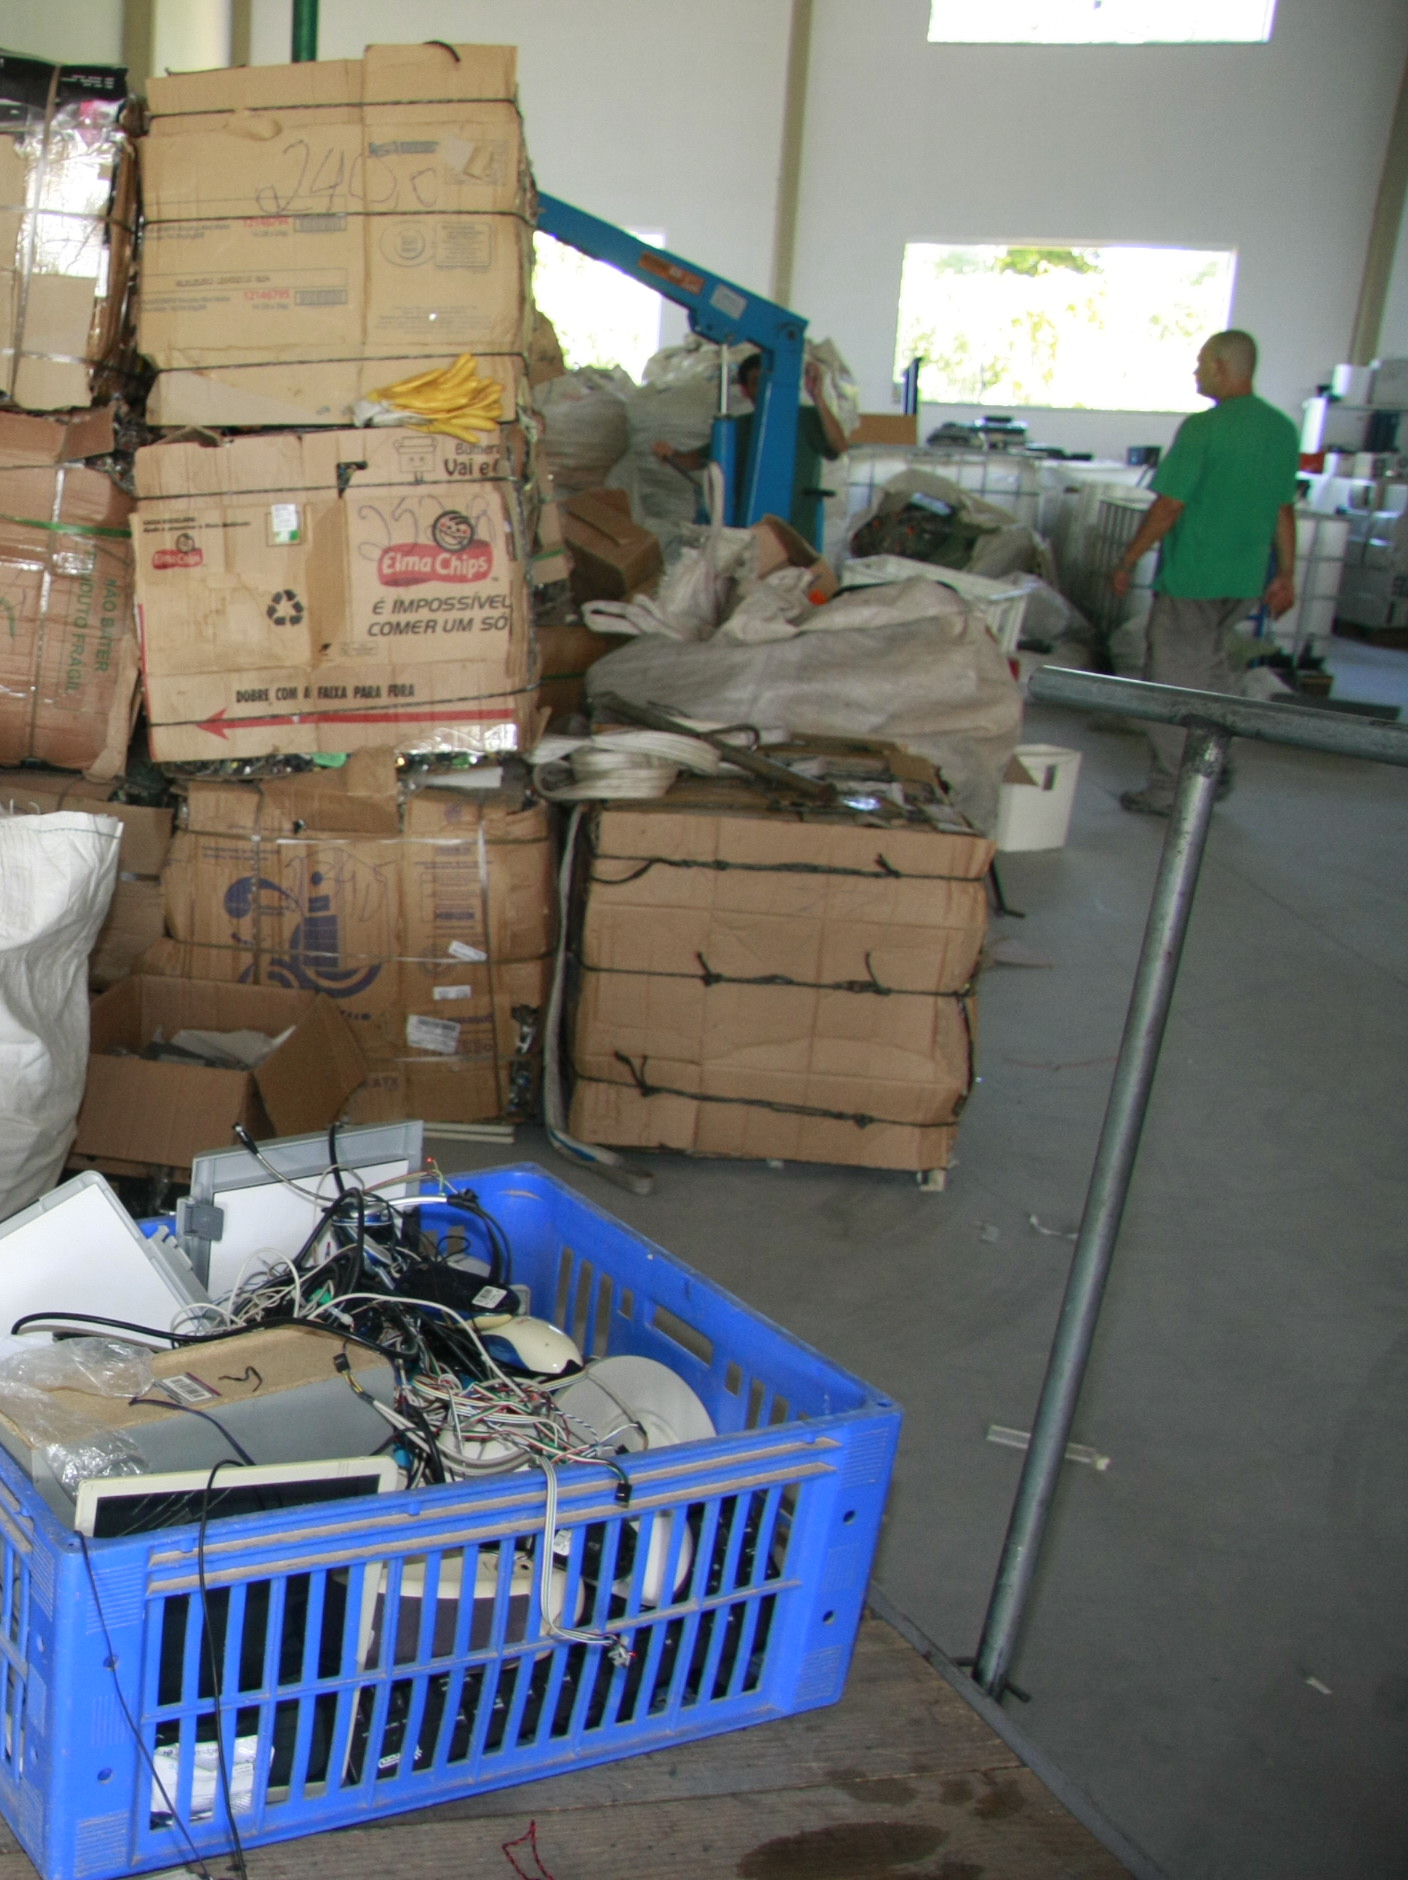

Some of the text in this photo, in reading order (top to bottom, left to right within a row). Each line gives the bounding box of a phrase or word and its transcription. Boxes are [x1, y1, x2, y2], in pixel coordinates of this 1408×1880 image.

[444, 458, 474, 476] Vai
[479, 463, 490, 476] e
[381, 551, 488, 579] Elma Chips
[372, 592, 512, 615] É IMPOSSÍVEL
[367, 612, 510, 637] COMER UM SÓ
[235, 683, 415, 703] DOBRE COM A FAIXA PARA FORA
